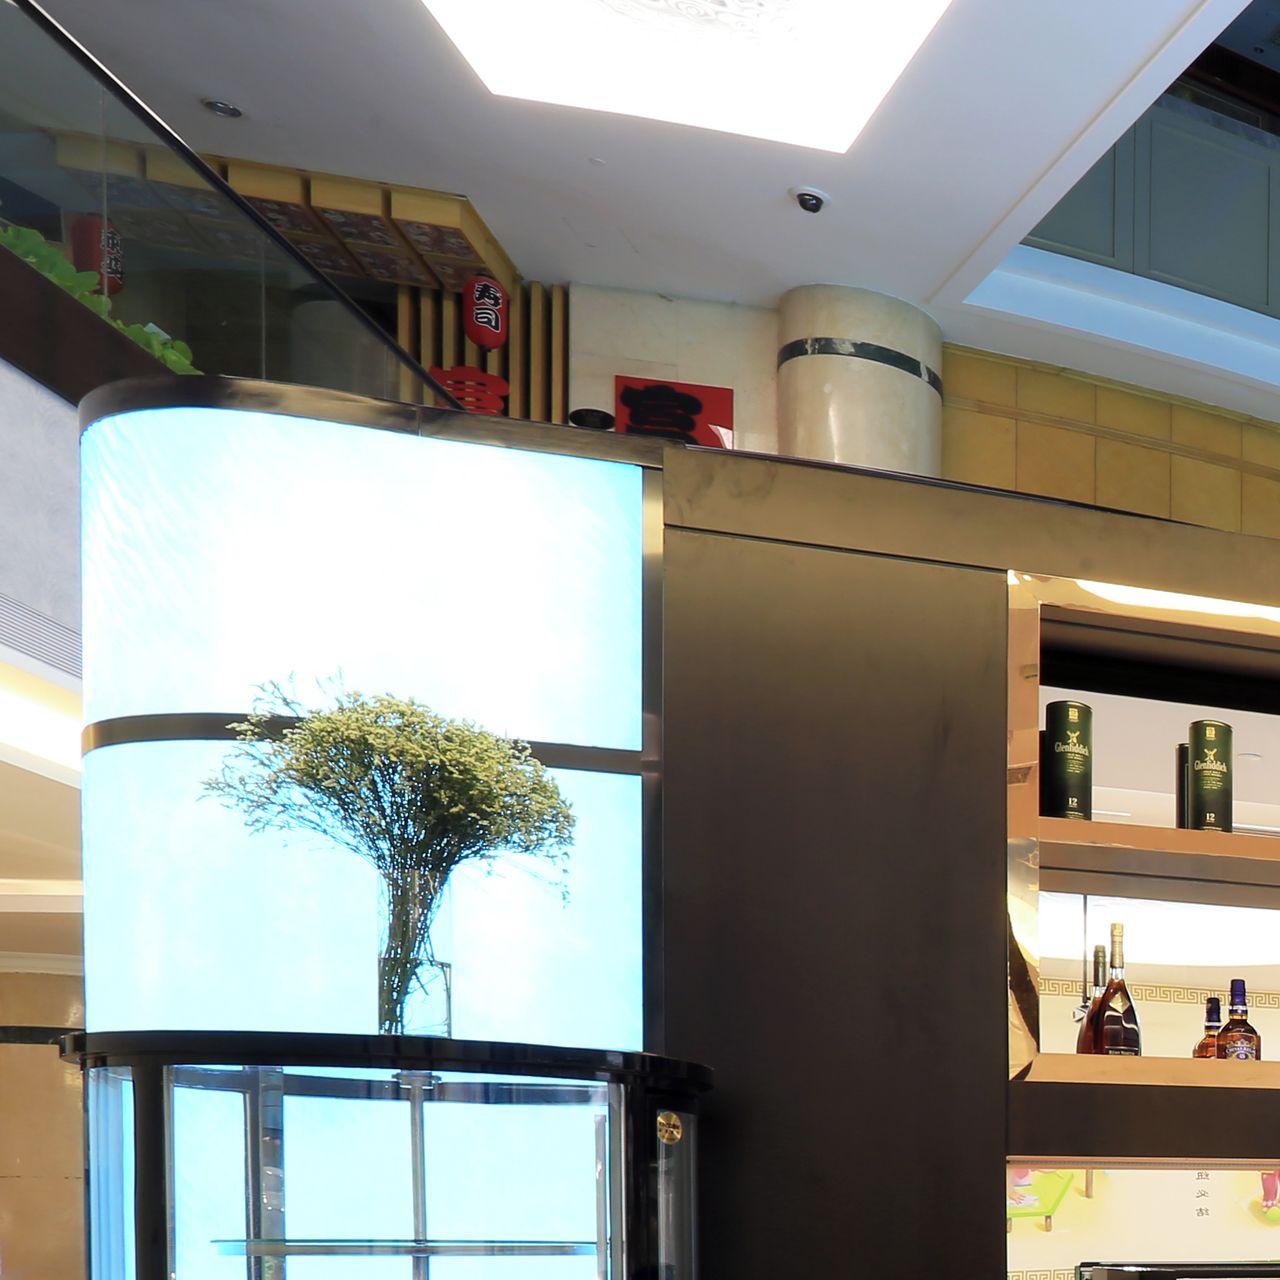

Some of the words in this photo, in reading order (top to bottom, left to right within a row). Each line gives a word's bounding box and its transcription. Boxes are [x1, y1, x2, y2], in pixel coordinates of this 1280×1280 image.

[474, 282, 502, 333] 寿司
[1054, 742, 1090, 757] Glenfiddich
[1194, 760, 1228, 773] Glenfiddich
[1068, 797, 1078, 807] 12
[1206, 813, 1216, 822] 12
